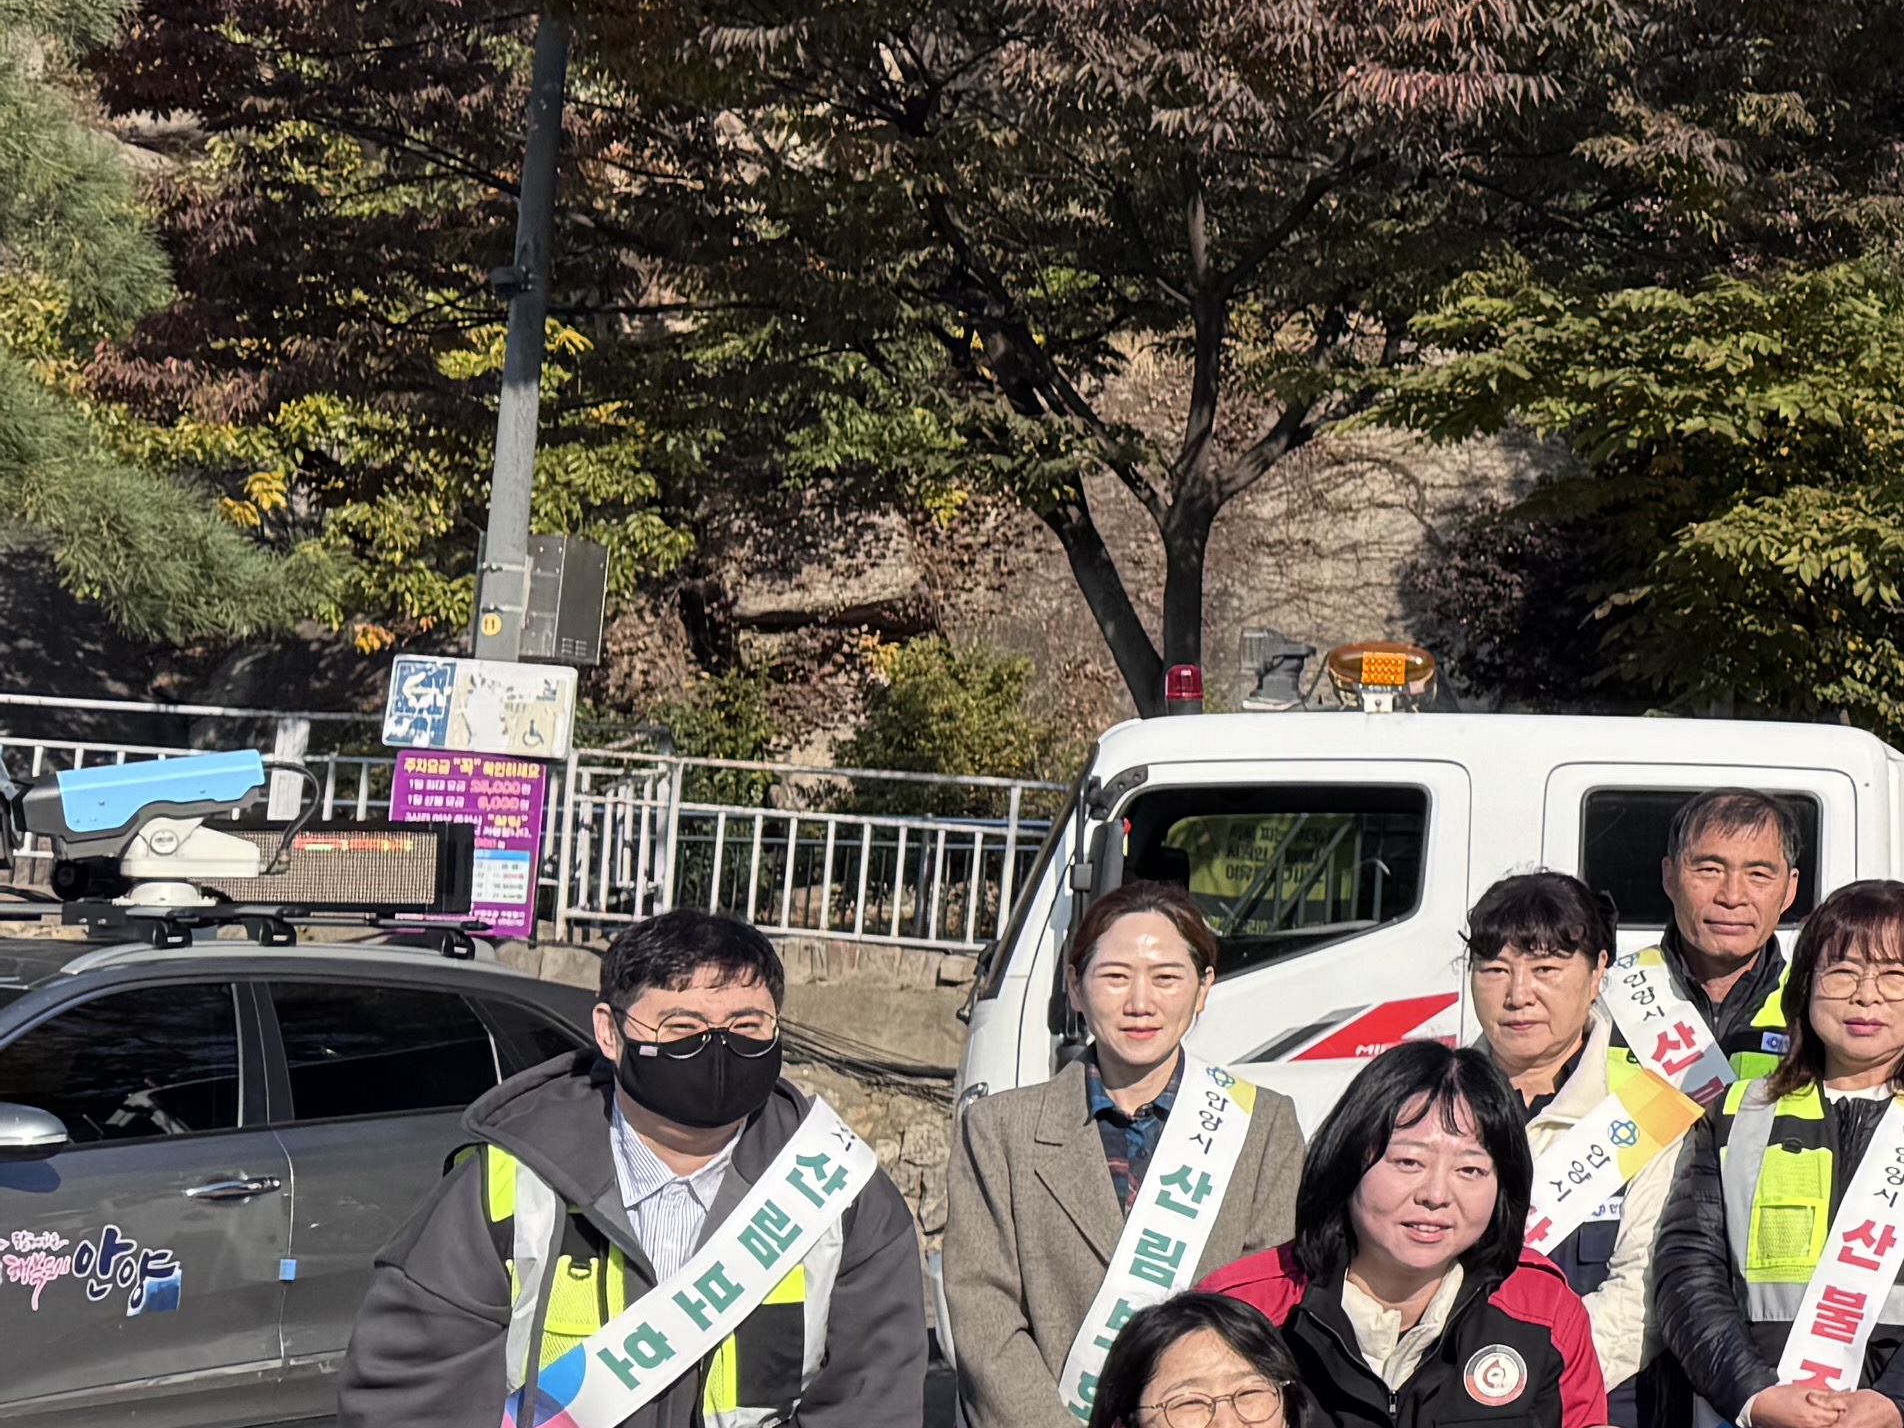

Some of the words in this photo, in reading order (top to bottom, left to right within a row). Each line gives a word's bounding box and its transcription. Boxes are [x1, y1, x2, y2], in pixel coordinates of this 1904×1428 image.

[1623, 969, 1666, 1022] 안양시
[1189, 1089, 1230, 1155] 안양시
[1548, 1143, 1611, 1203] 안양시
[72, 1225, 181, 1315] 안양
[596, 1152, 849, 1391] 산림보호
